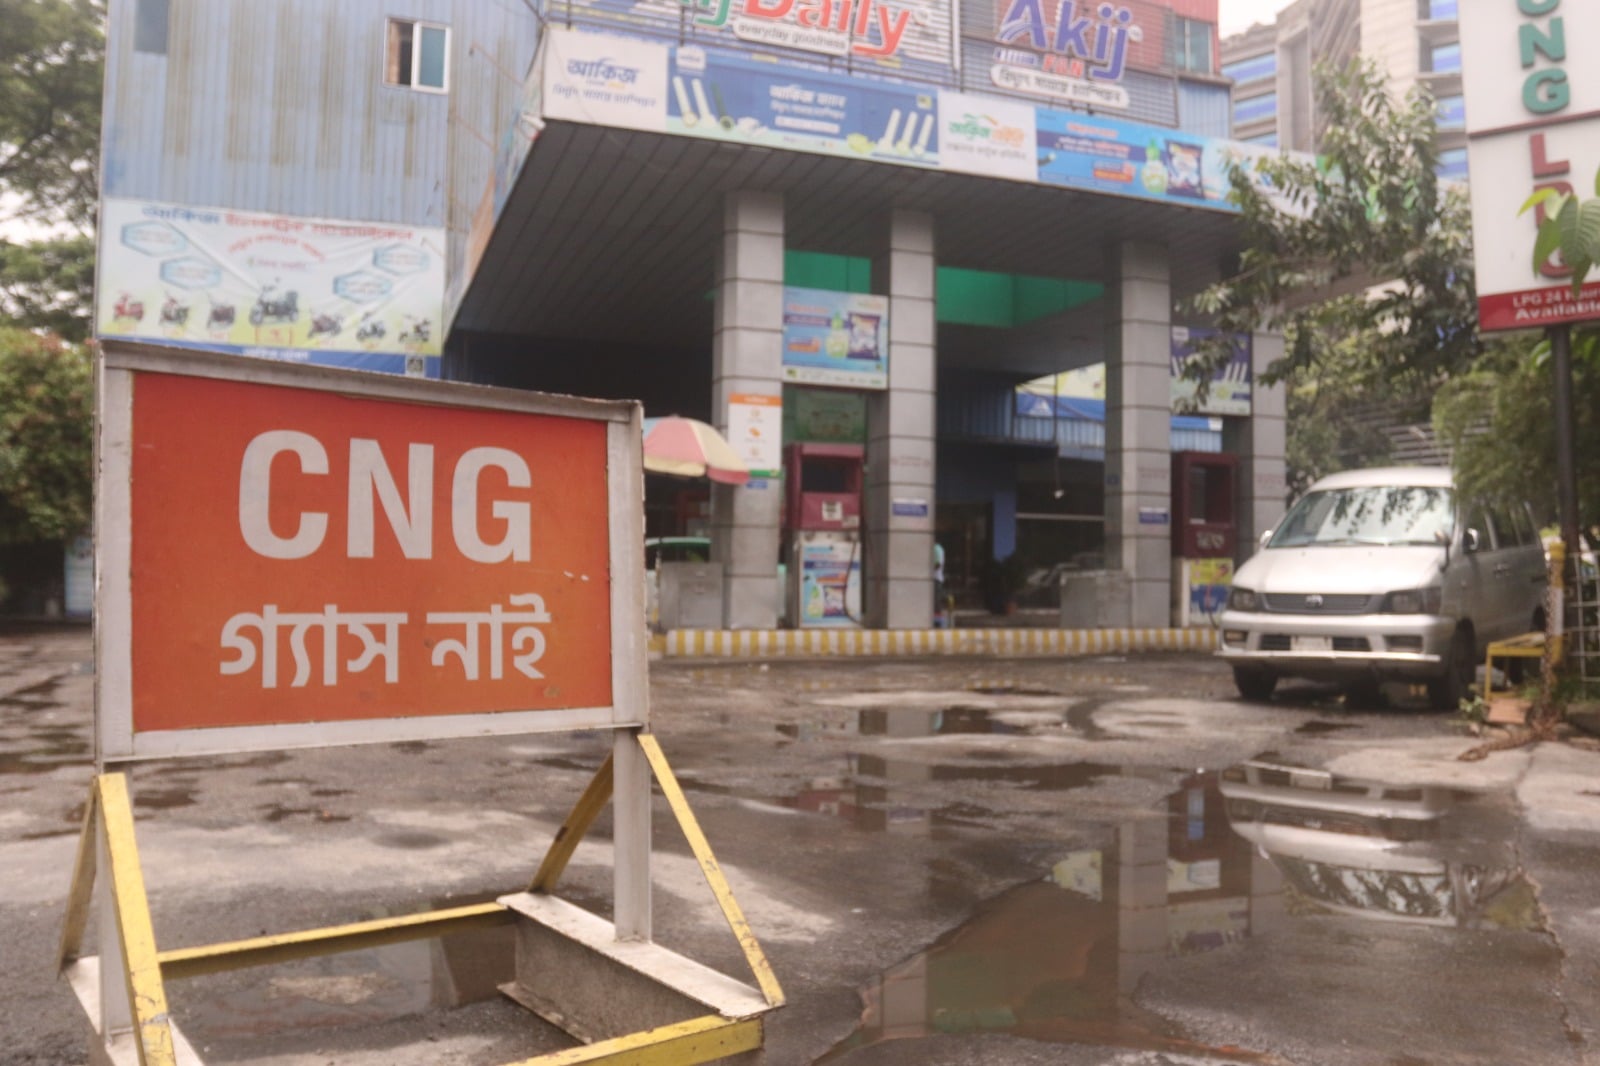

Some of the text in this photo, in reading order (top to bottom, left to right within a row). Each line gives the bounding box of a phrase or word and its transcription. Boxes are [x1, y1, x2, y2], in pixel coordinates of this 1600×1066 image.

[738, 23, 846, 49] everyday goodness
[1512, 292, 1542, 308] LPG
[239, 430, 531, 563] CNG
[220, 592, 552, 689] গ্যাস নাই
